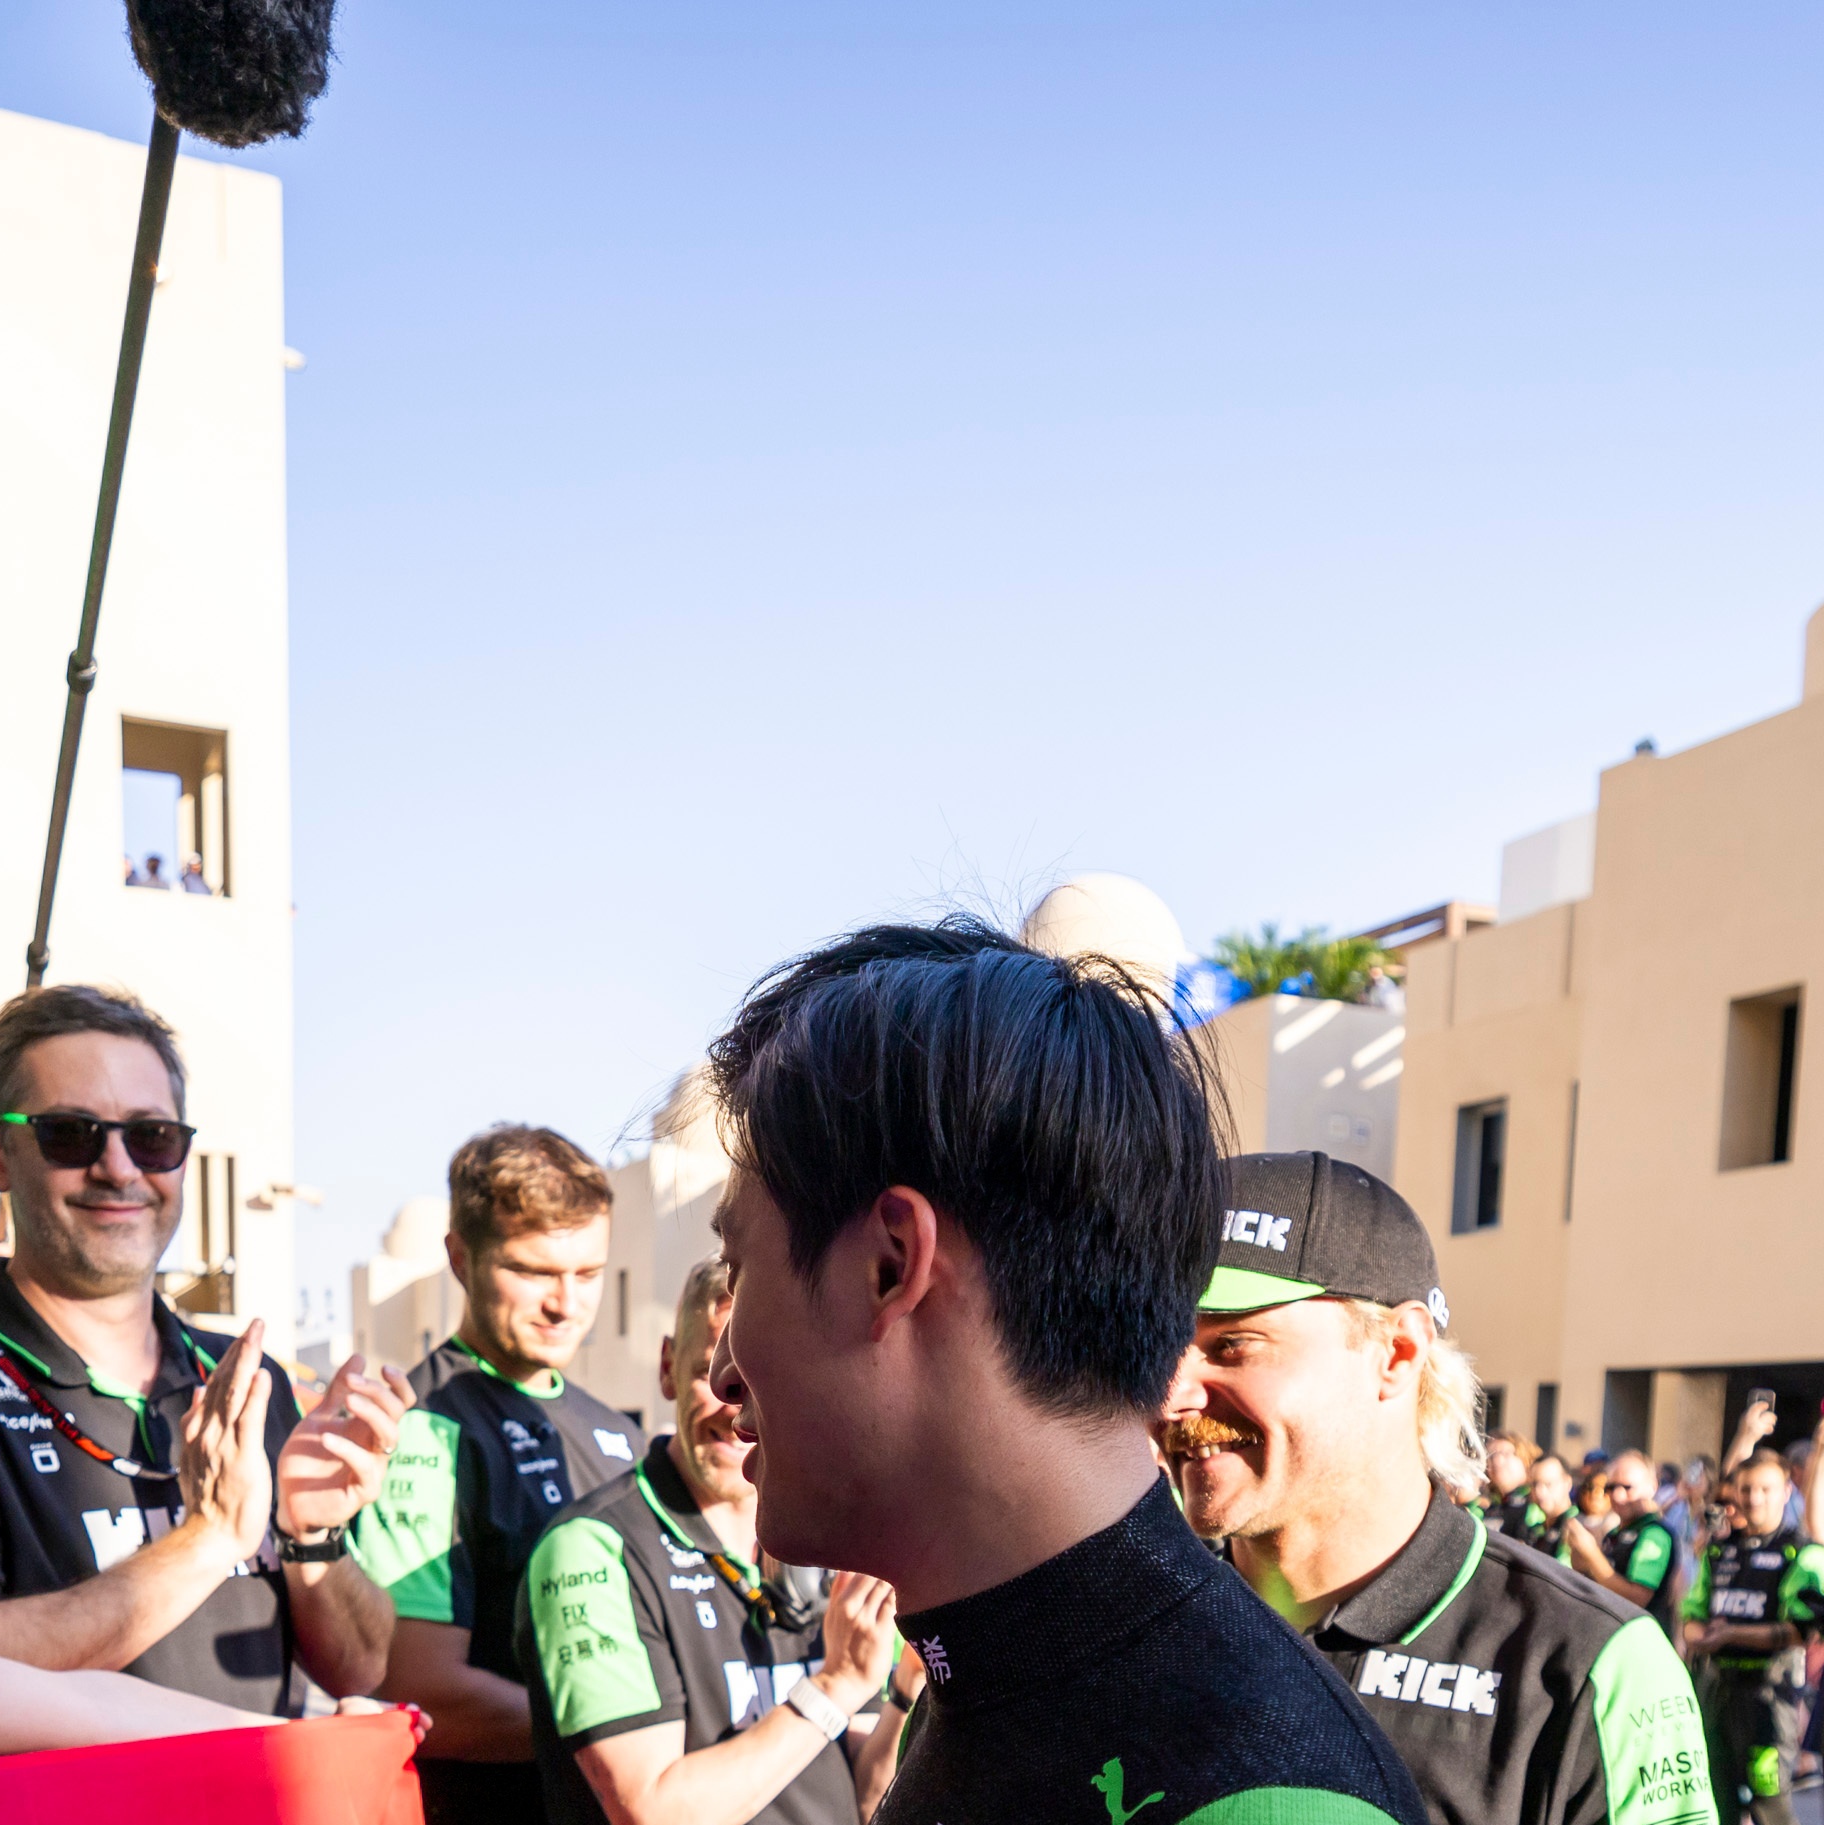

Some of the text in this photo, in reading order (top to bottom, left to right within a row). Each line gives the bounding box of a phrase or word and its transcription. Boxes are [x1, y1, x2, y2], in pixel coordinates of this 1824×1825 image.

[541, 1567, 608, 1598] Hyland
[562, 1602, 587, 1622] FIX
[1357, 1648, 1503, 1716] KICK
